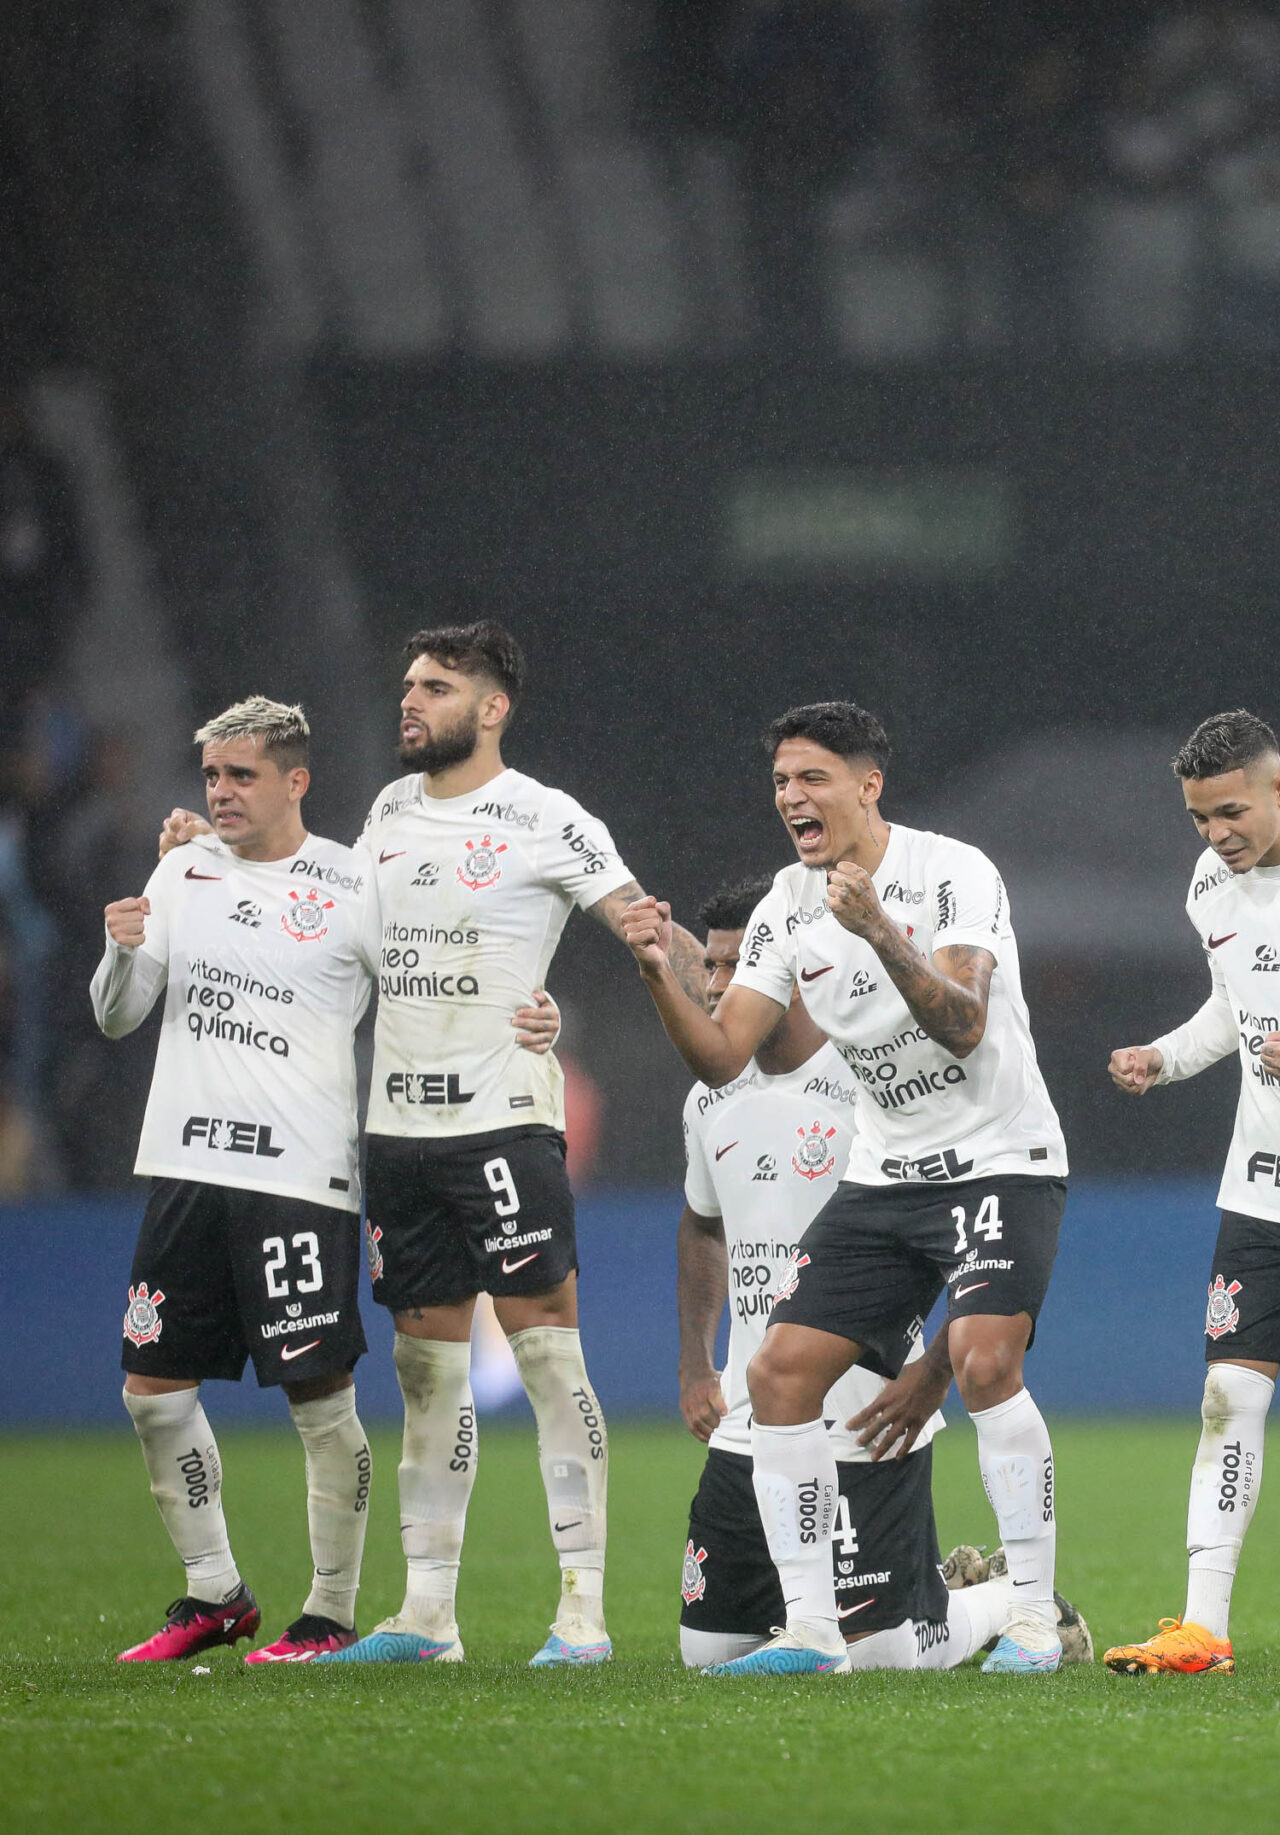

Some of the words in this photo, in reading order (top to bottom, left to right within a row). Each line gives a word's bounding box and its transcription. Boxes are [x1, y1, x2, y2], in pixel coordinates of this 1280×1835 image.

[569, 834, 606, 874] bmg
[290, 860, 363, 894] pixbet
[410, 878, 439, 886] ALE
[228, 914, 263, 928] ALE
[384, 921, 479, 944] vitaminas
[187, 959, 294, 1004] vitaminas
[381, 970, 479, 1002] química
[1251, 963, 1280, 972] ALE
[188, 985, 233, 1011] neo
[849, 983, 877, 999] ALE
[188, 1011, 289, 1057] química
[483, 1157, 521, 1216] 9
[752, 1172, 778, 1181] ALE
[484, 1227, 552, 1252] UniCesumar
[951, 1194, 1003, 1254] 14
[262, 1231, 324, 1298] 23
[733, 1265, 771, 1288] neo
[261, 1310, 341, 1338] UniCesumar
[449, 1403, 474, 1473] TODOS
[573, 1387, 604, 1460] TODOS
[176, 1448, 208, 1509] TODOS
[354, 1443, 371, 1513] TODOS
[1043, 1451, 1053, 1522] TODOS
[1218, 1441, 1241, 1512] TODOS
[798, 1477, 819, 1544] TODOS
